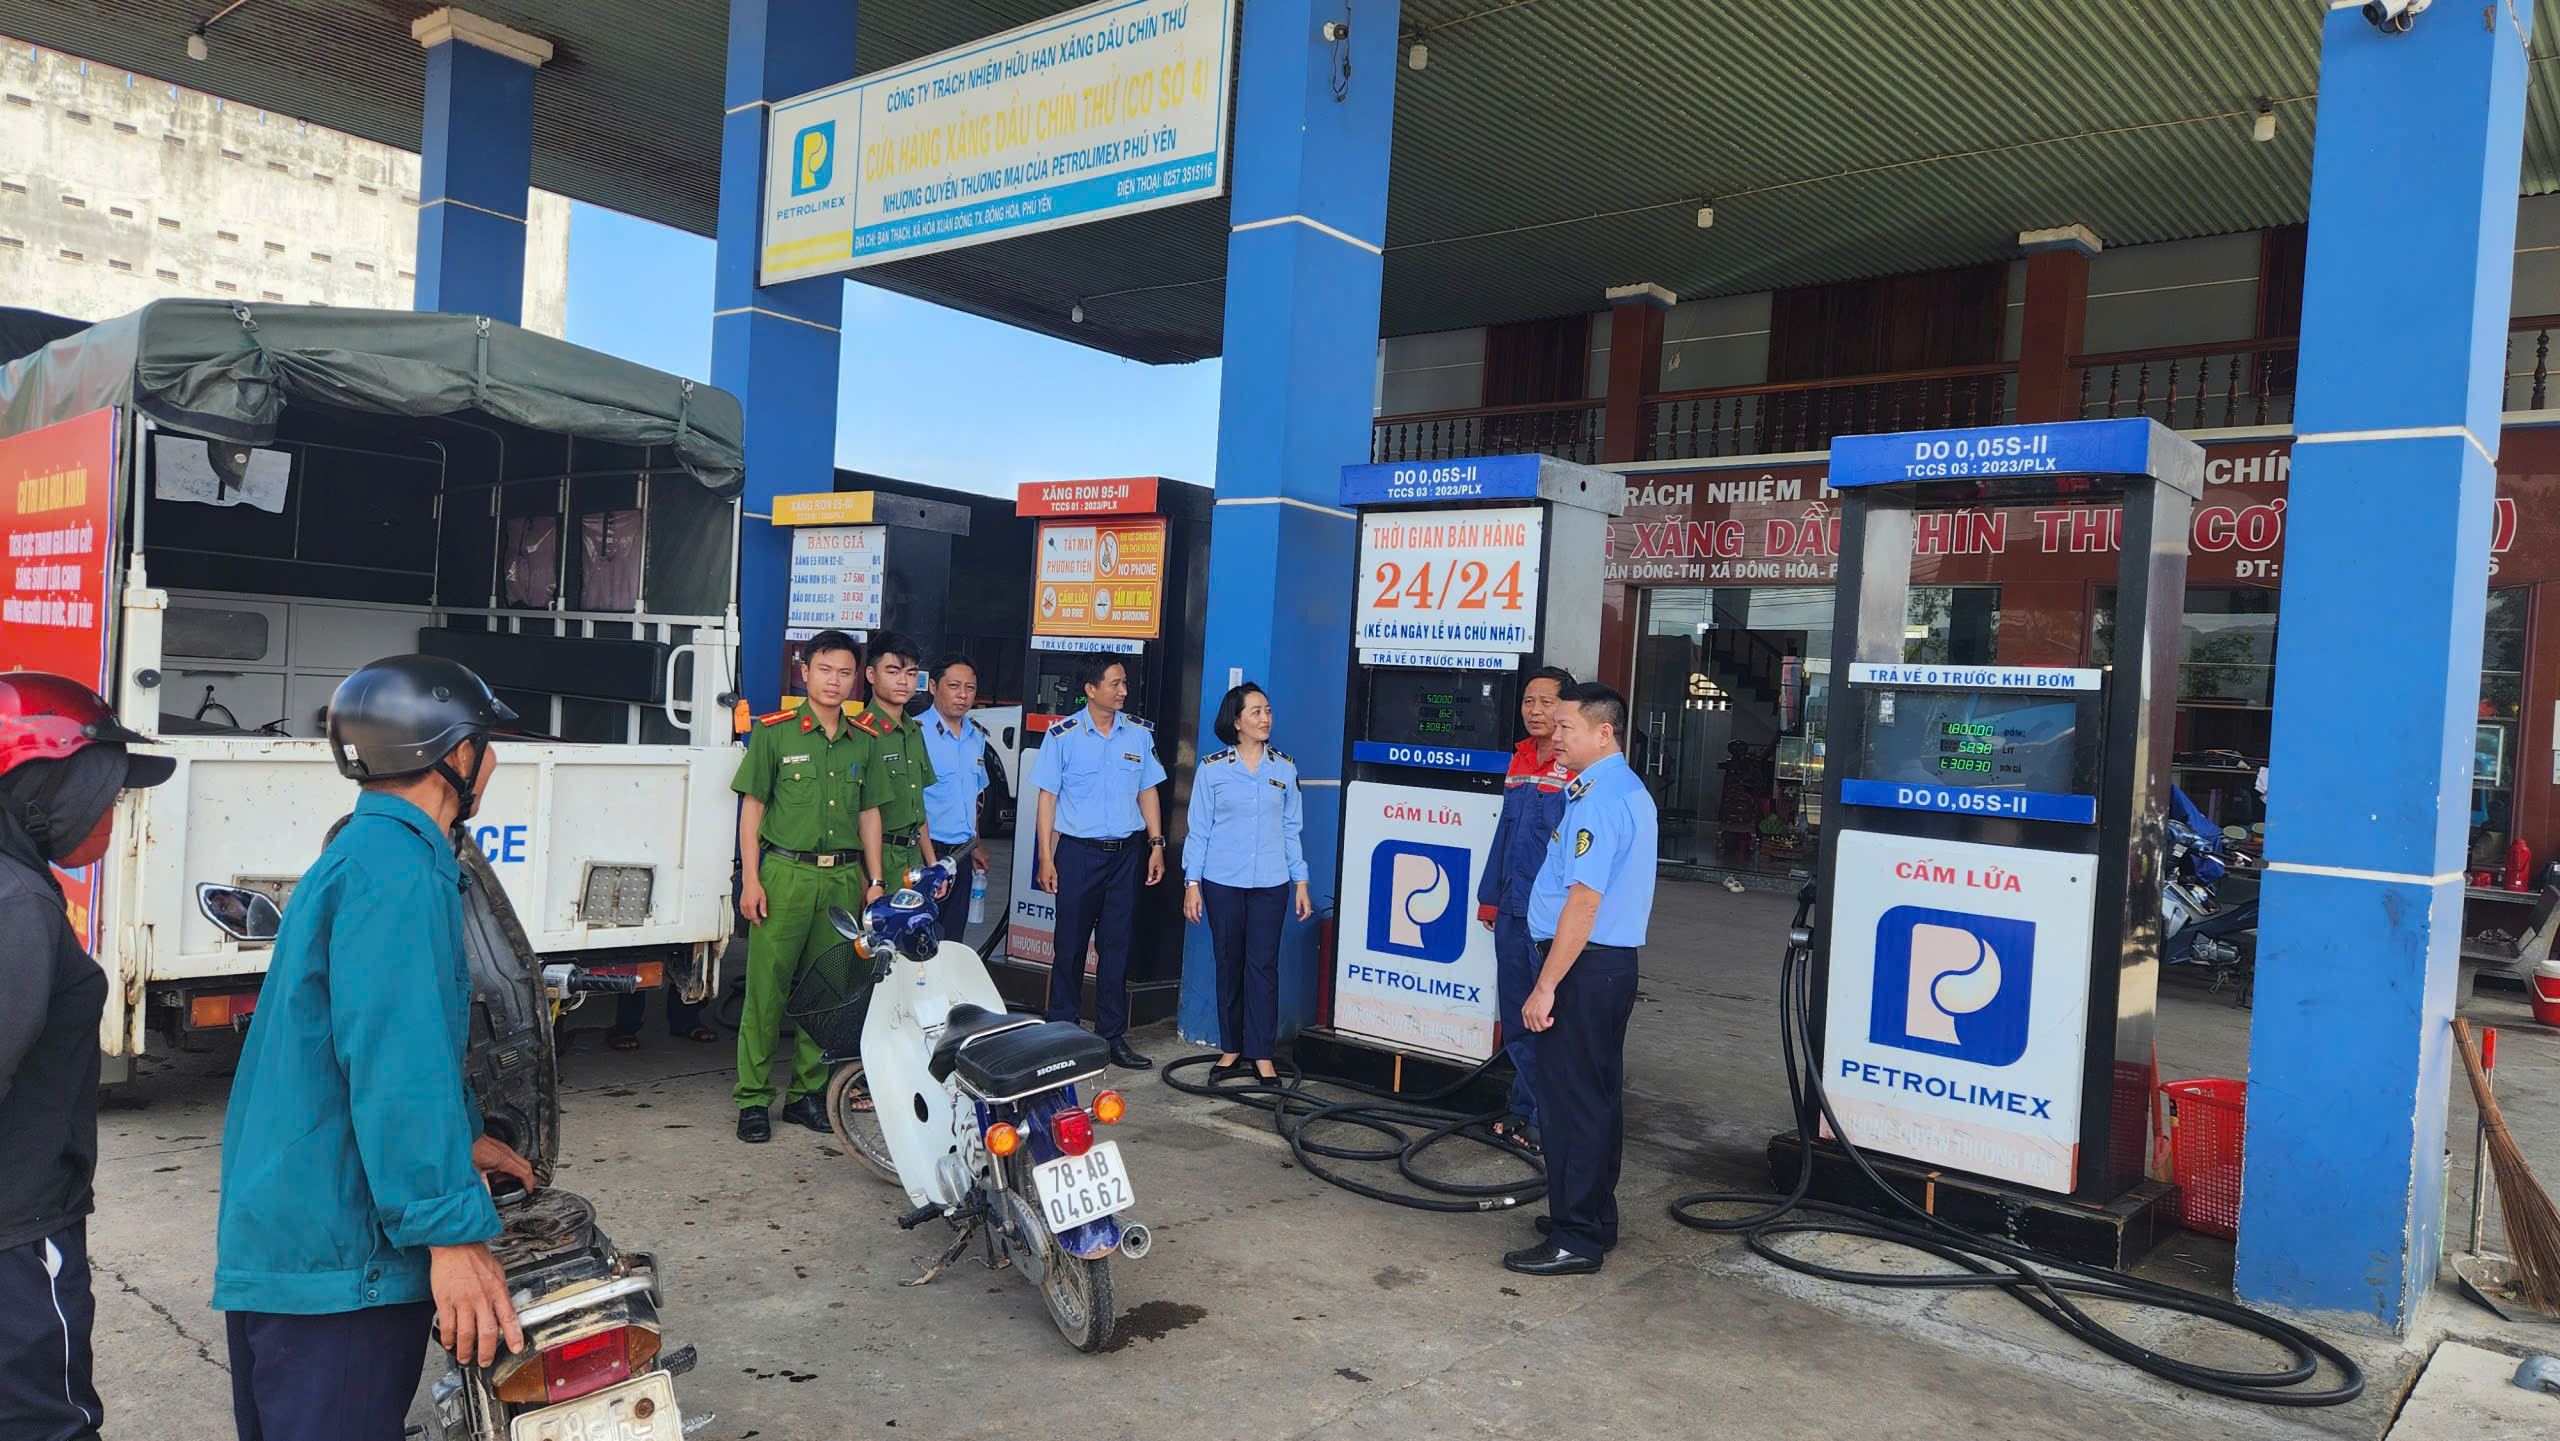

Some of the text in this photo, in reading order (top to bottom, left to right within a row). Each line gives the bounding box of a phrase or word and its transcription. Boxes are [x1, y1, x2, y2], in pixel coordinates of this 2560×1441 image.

[887, 87, 915, 113] CÔNG
[918, 83, 930, 105] TY
[932, 71, 966, 100] TRÁCH
[968, 59, 1002, 91] NHIỆM
[1031, 46, 1056, 76] HẠN
[1059, 33, 1093, 64] XĂNG
[1097, 18, 1124, 52] DẦU
[1128, 11, 1157, 45] CHÍN
[882, 189, 922, 214] NHƯỢNG
[924, 172, 957, 203] QUYỀN
[1004, 165, 1024, 190] MẠI
[1026, 152, 1048, 182] CỦA
[1052, 141, 1120, 177] PETROLIMEX
[1123, 129, 1149, 160] PHÚ
[1153, 124, 1176, 153] YÊN
[1117, 176, 1135, 198] ĐIỆN
[1163, 169, 1180, 188] 0257
[1182, 162, 1212, 184] 3515116
[776, 196, 846, 220] PETROLIMEX
[1916, 435, 2048, 461] DO 0,05S-II
[1394, 466, 1477, 486] DO 0,05S-II
[1905, 457, 2057, 477] TCCS 03 2023/PLX
[1042, 485, 1129, 501] XĂNG RON 95-III
[1388, 484, 1482, 498] TCCS 03 2023/PLX
[1625, 480, 1693, 507] RÁCH
[1707, 474, 1801, 505] NHIỆM
[1051, 502, 1070, 511] TCCS
[1071, 502, 1080, 511] 01
[808, 531, 865, 550] BẢNG GIÁ
[1077, 533, 1093, 551] MÁY
[1373, 518, 1526, 549] THỜI GIAN BÁN HÀNG
[1630, 514, 1745, 558] XĂNG
[1911, 508, 2008, 555] HÍN
[1076, 558, 1092, 576] TIỆN
[1118, 563, 1157, 576] NO PHONE
[1710, 560, 1731, 579] XÃ
[1735, 560, 1779, 579] ĐÔNG
[2236, 559, 2279, 578] ĐT:
[1372, 559, 1524, 611] 24/24
[1062, 608, 1071, 617] NO
[1111, 611, 1149, 621] NO SMOKING
[1384, 619, 1398, 639] CẢ
[1400, 622, 1428, 640] NGÀY
[1431, 618, 1444, 640] LỄ
[1448, 622, 1461, 640] VÀ
[1464, 620, 1487, 640] CHỦ
[1489, 622, 1525, 644] NHẬT)
[1041, 638, 1055, 649] TRẢ
[1100, 643, 1114, 652] KHI
[1116, 643, 1133, 652] BƠM
[1373, 651, 1503, 668] TRẢ VỀ TRƯỚC KHI BƠM
[1869, 665, 2075, 687] TRẢ VỀ TRƯỚC KHI BƠM
[1389, 747, 1471, 767] DO 0,05S-II
[1899, 788, 2028, 815] DO 0,05S-II
[1384, 800, 1462, 826] CẤM LỬA
[1895, 858, 2023, 894] CẤM LỬA
[1348, 964, 1481, 1003] PETROLIMEX
[1037, 1059, 1077, 1077] HONDA
[1841, 1058, 2053, 1120] PETROLIMEX
[1048, 1150, 1110, 1193] 78-AB
[1050, 1177, 1128, 1225] 046.62
